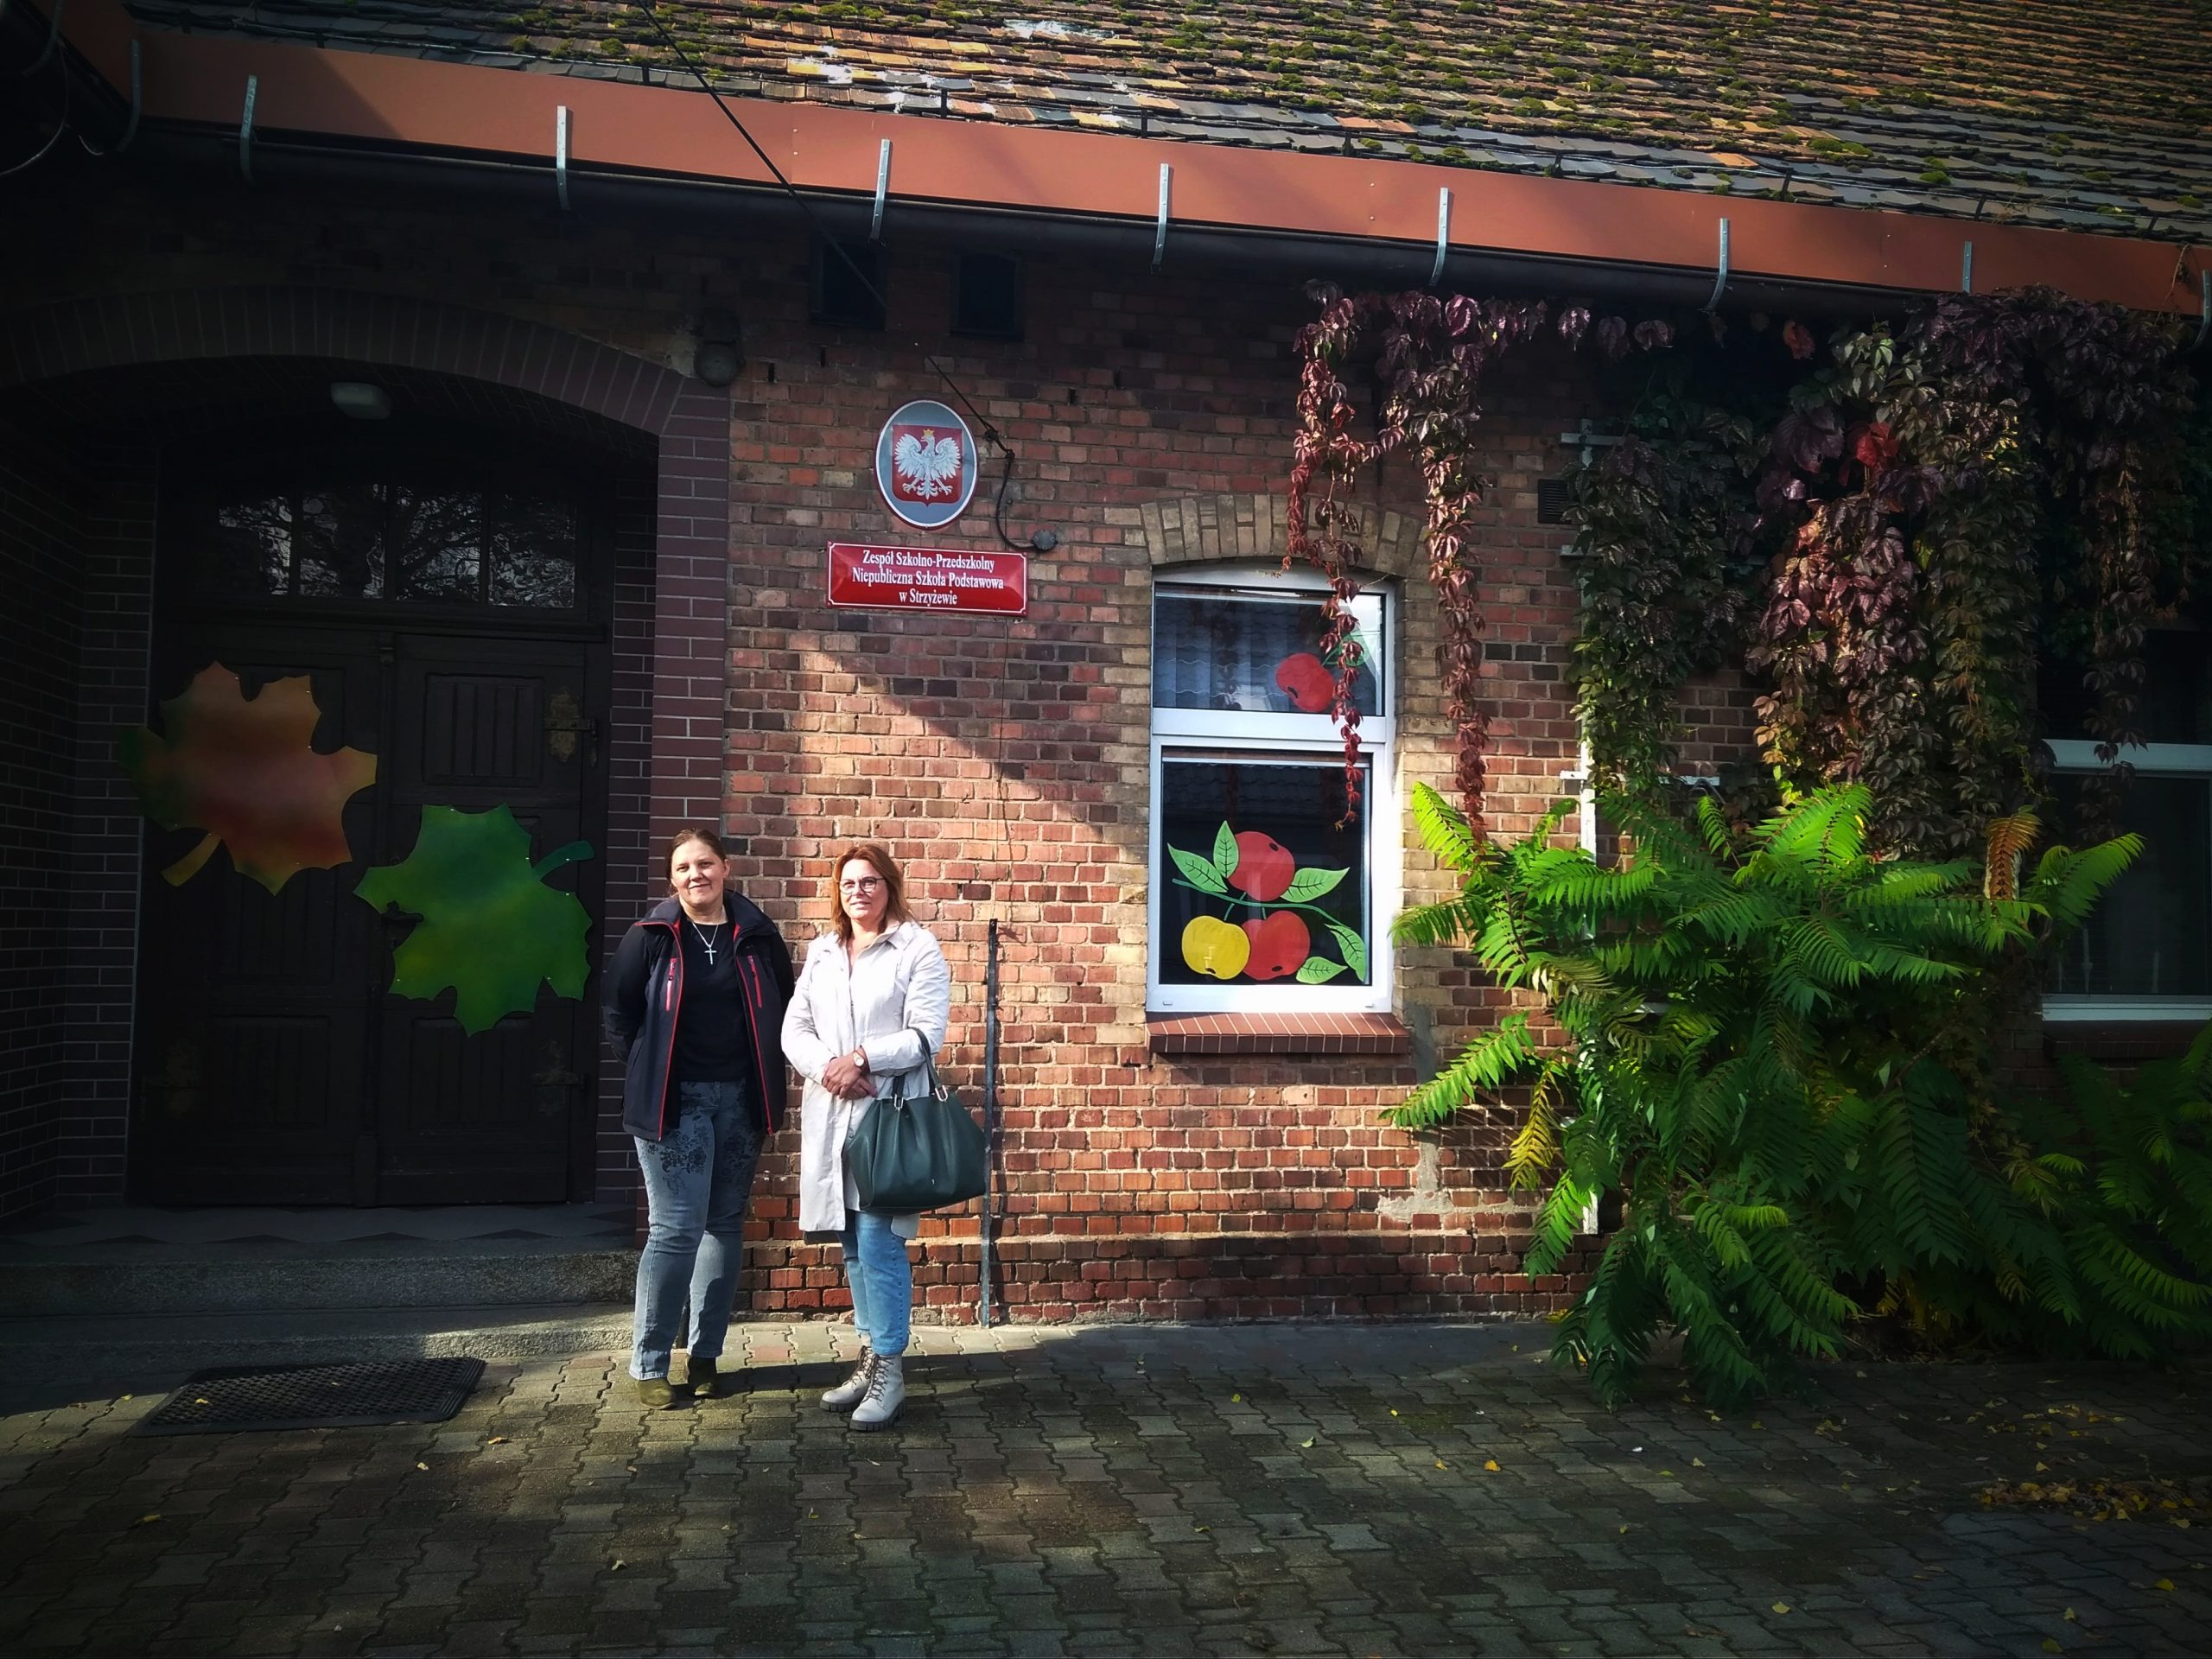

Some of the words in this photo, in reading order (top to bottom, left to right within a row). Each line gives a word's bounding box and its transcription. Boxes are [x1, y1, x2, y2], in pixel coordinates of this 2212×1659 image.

[862, 550, 894, 568] Zespół
[896, 552, 995, 573] Szkolno-Przedszkolny
[852, 568, 913, 587] Niepubliczna
[916, 570, 946, 587] Szkoła
[948, 573, 1004, 589] Podstawowa
[899, 592, 908, 602] w
[910, 588, 957, 607] Strzyżewie
